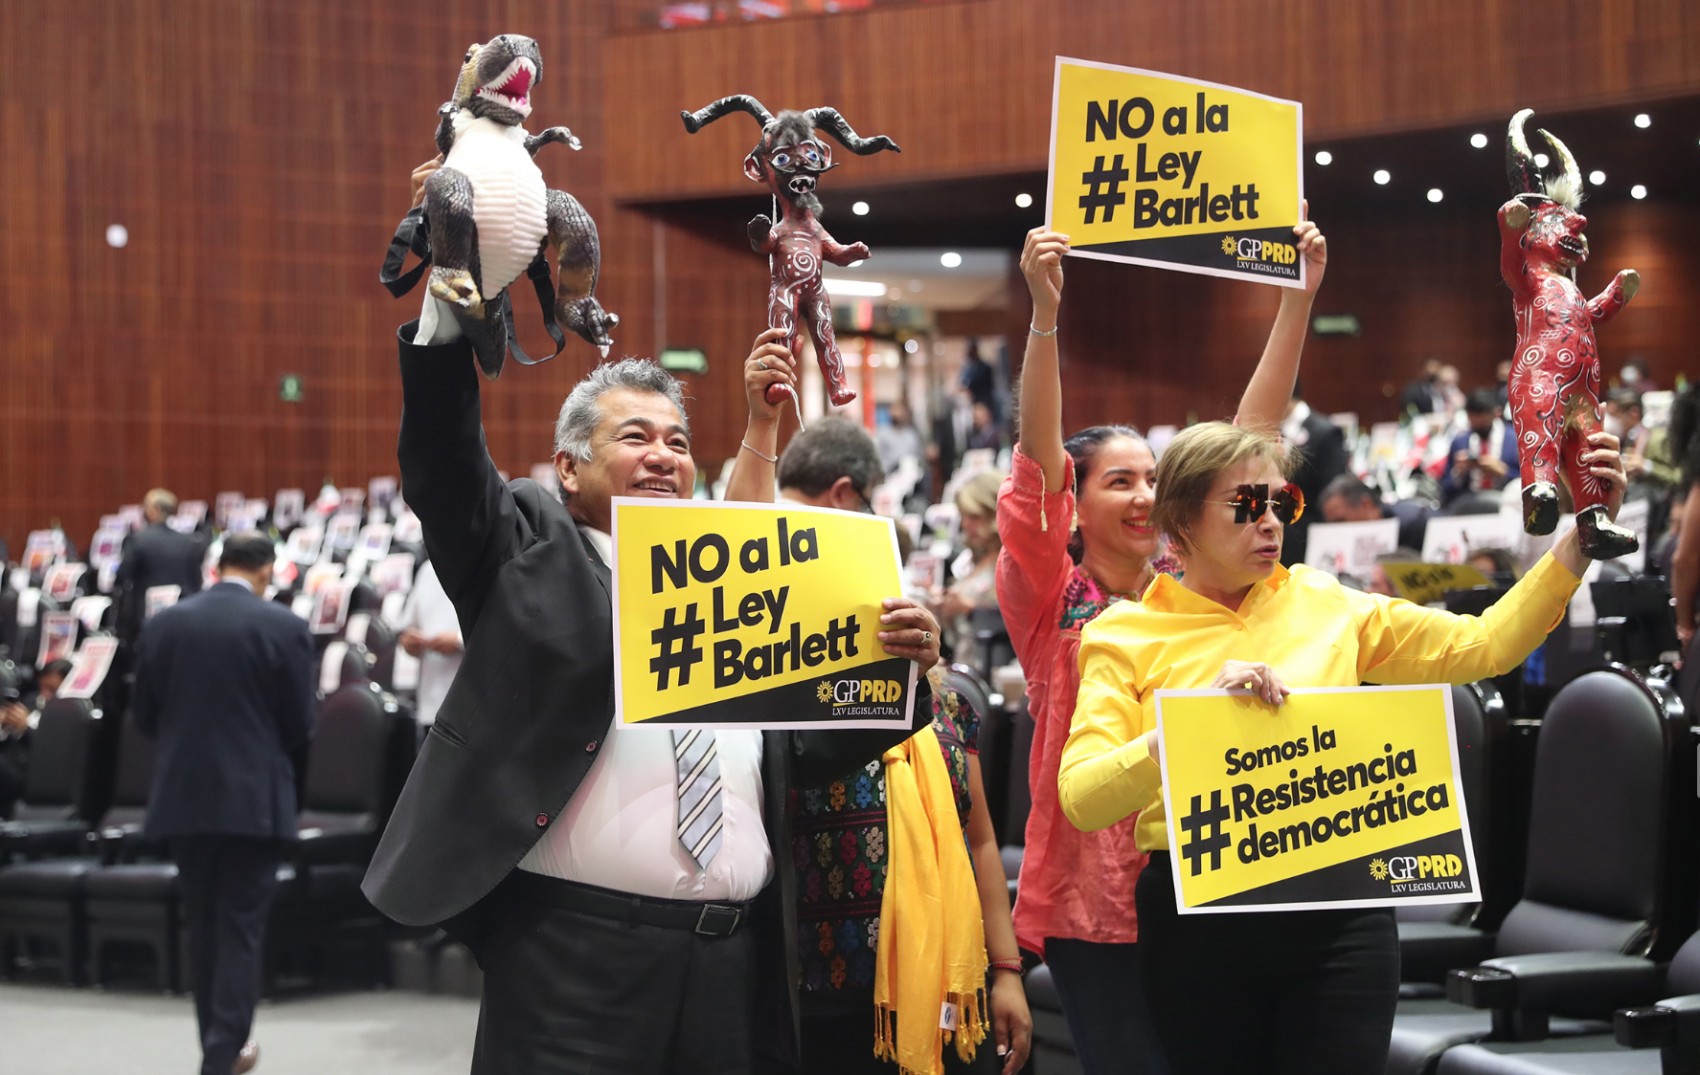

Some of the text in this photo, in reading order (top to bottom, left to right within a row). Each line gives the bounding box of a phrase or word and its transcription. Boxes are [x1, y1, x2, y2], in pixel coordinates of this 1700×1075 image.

[1085, 92, 1229, 143] NO a la
[1135, 142, 1203, 190] Ley
[1133, 182, 1260, 229] Barlett
[1236, 260, 1297, 277] LXV LEGISLATURA
[650, 517, 819, 595] NO a la
[712, 585, 790, 635] Ley
[713, 614, 861, 690] Barlett
[832, 706, 900, 716] LXV LEGISLATURA
[1224, 724, 1337, 776] Somos la
[1231, 743, 1418, 823] Resistencia
[1237, 782, 1450, 865] democrática
[1391, 880, 1466, 893] LXV LEGISLATURA
